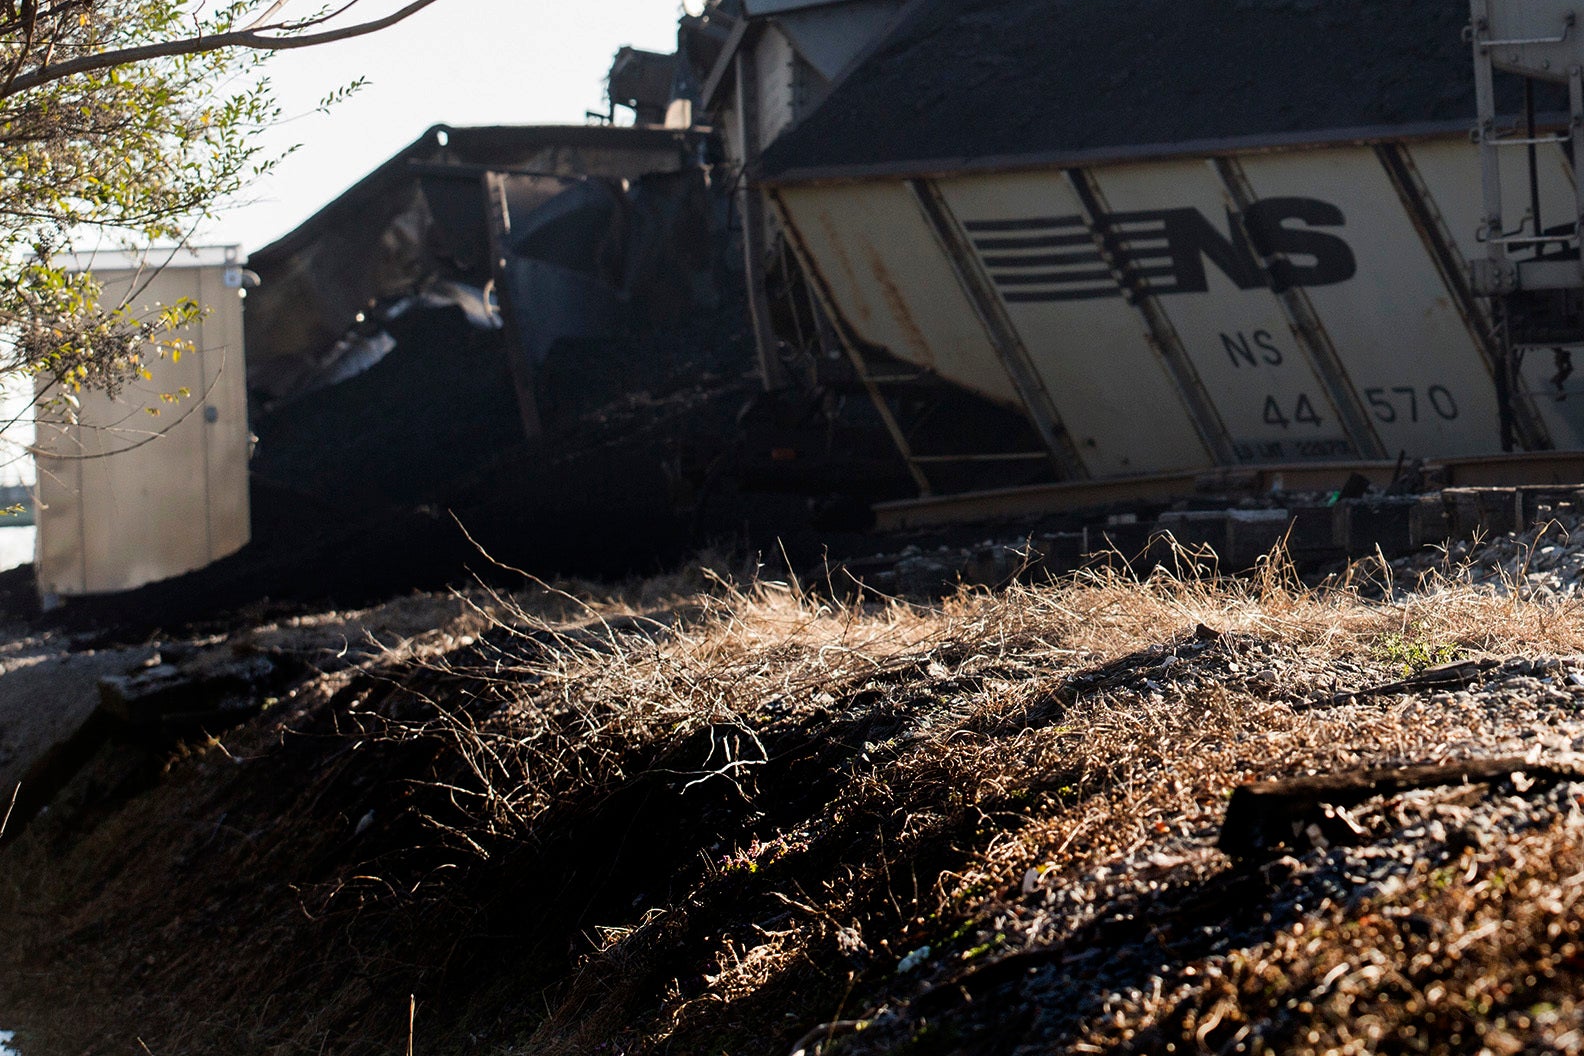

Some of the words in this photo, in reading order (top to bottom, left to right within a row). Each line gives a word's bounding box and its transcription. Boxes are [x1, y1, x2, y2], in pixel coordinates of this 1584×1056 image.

[1160, 196, 1358, 294] NS
[1219, 330, 1283, 368] NS
[1263, 394, 1323, 431] 44
[1365, 384, 1459, 424] 570
